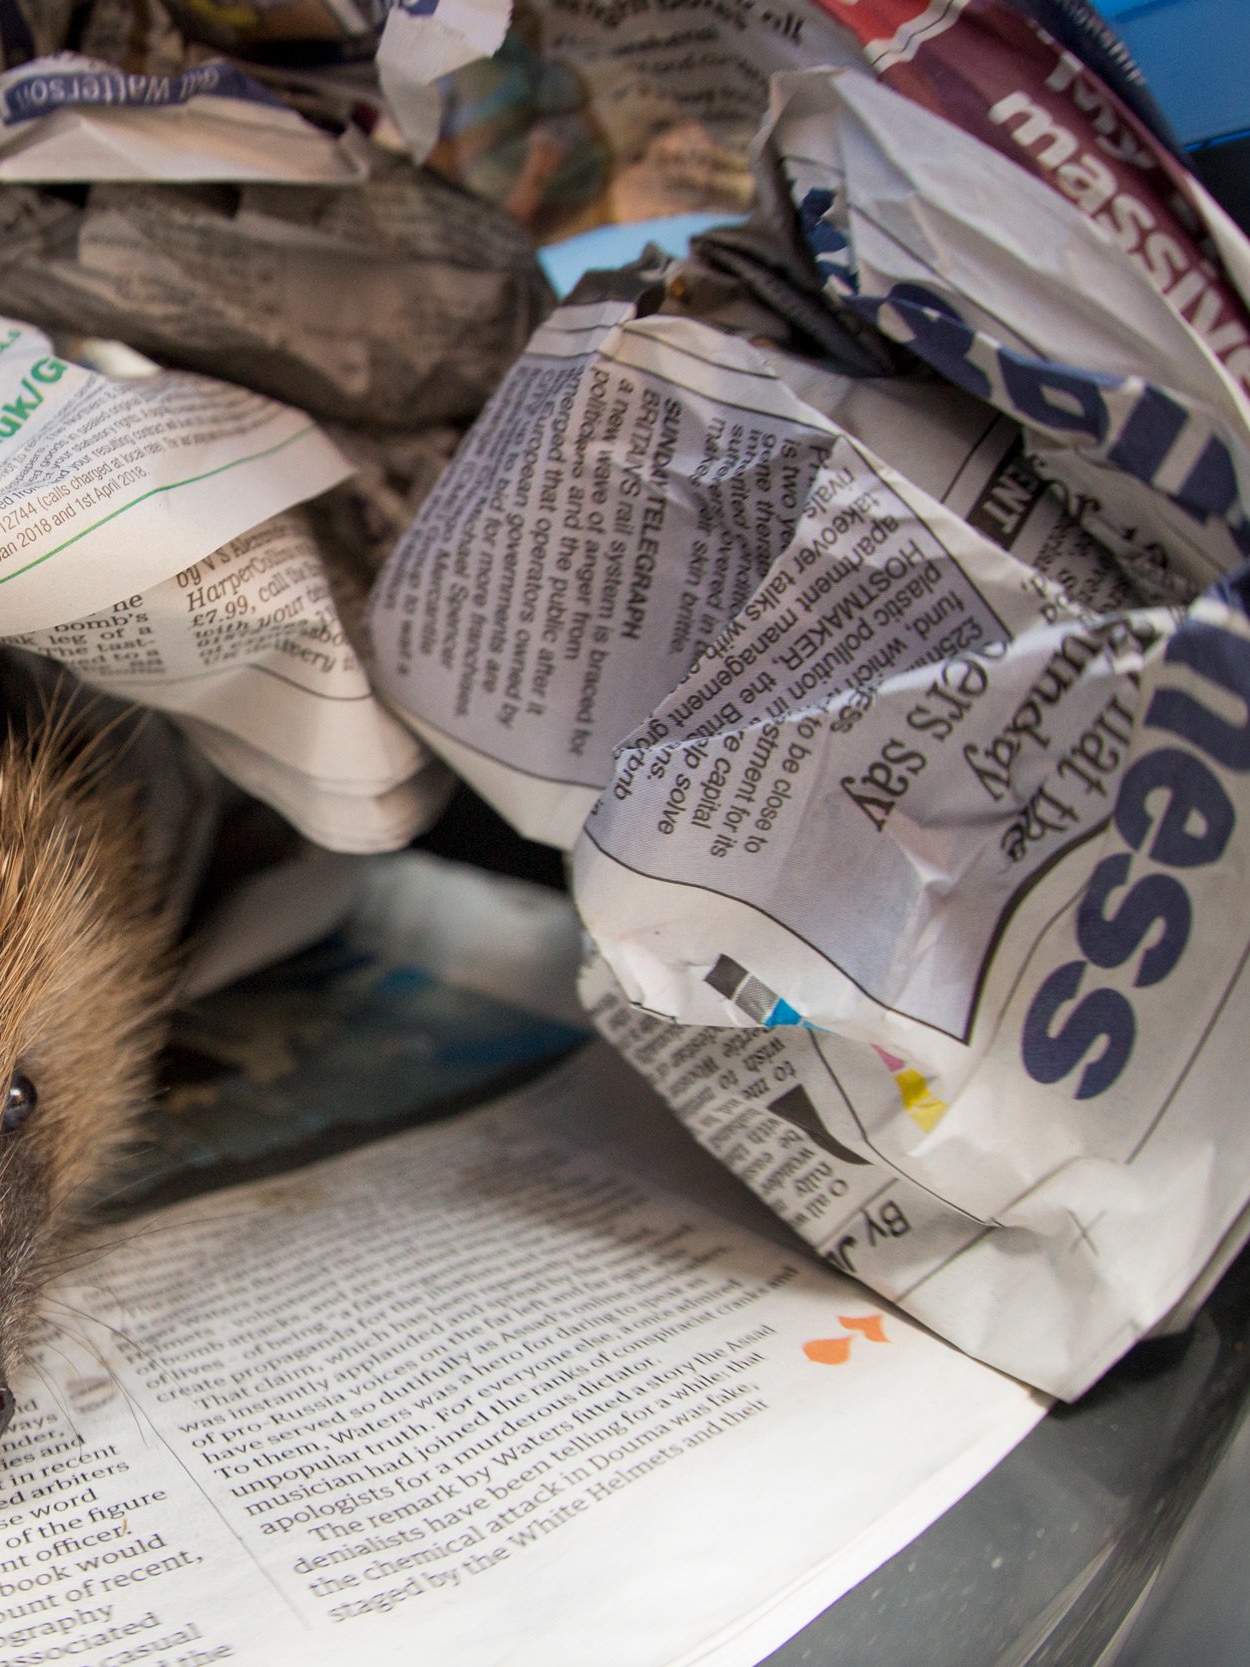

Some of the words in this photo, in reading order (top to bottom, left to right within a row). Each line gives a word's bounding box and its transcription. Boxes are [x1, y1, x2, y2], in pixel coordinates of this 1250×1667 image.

[17, 518, 53, 548] 2018
[51, 501, 77, 523] and
[75, 489, 99, 512] 1st
[94, 473, 126, 503] April
[122, 466, 151, 490] 2018.
[564, 486, 585, 531] and
[613, 499, 635, 537] rail
[793, 492, 880, 574] takeover
[556, 535, 580, 571] the
[597, 540, 626, 619] system
[621, 495, 668, 641] TELEGRAPH
[796, 516, 901, 613] apartment
[190, 596, 257, 628] £7.99,
[258, 579, 283, 602] call
[542, 576, 569, 644] public
[745, 570, 796, 623] talks
[774, 540, 926, 671] HOSTMAKER,
[872, 559, 942, 627] plastic
[906, 589, 965, 641] fund,
[593, 624, 611, 645] is
[687, 608, 797, 711] management
[787, 617, 874, 700] pollution
[530, 647, 555, 699] after
[576, 648, 609, 724] braced
[738, 671, 777, 705] the
[526, 700, 547, 717] it
[796, 714, 824, 741] to
[782, 743, 813, 775] be
[840, 738, 927, 833] say
[658, 772, 691, 836] solve
[691, 755, 731, 831] capital
[755, 777, 791, 831] close
[1000, 781, 1079, 862] the
[744, 832, 769, 854] to
[40, 1434, 87, 1460] and
[260, 1487, 395, 1536] apologists
[396, 1472, 431, 1493] for
[436, 1463, 452, 1475] a
[456, 1392, 576, 1465] murderous
[578, 1358, 661, 1397] dictator.
[308, 1572, 360, 1598] the
[364, 1526, 485, 1581] chemical
[486, 1480, 565, 1534] attack
[560, 1465, 590, 1486] in
[588, 1423, 672, 1472] Douma
[507, 1497, 590, 1548] White
[585, 1442, 684, 1502] Helmets
[74, 1532, 167, 1574] would
